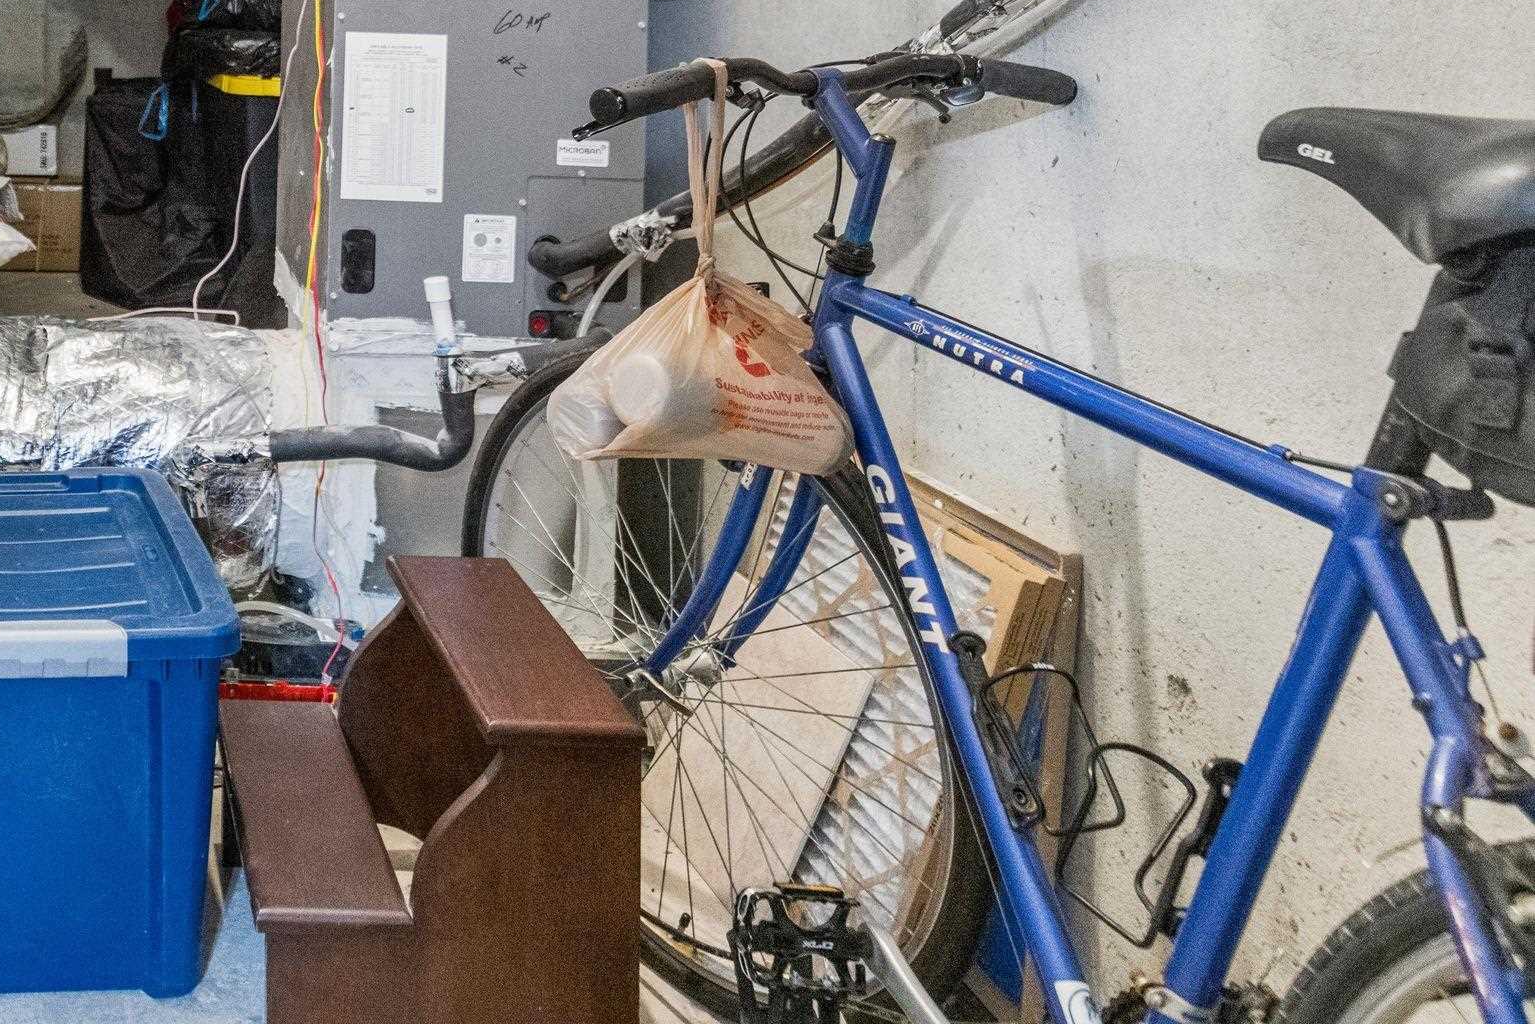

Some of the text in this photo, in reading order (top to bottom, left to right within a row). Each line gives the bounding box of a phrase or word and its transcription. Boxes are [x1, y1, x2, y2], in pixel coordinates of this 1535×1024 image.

[1296, 142, 1336, 165] GEL
[932, 334, 1024, 385] NUTRA
[714, 376, 792, 404] Sustainability
[866, 463, 950, 655] GIANT
